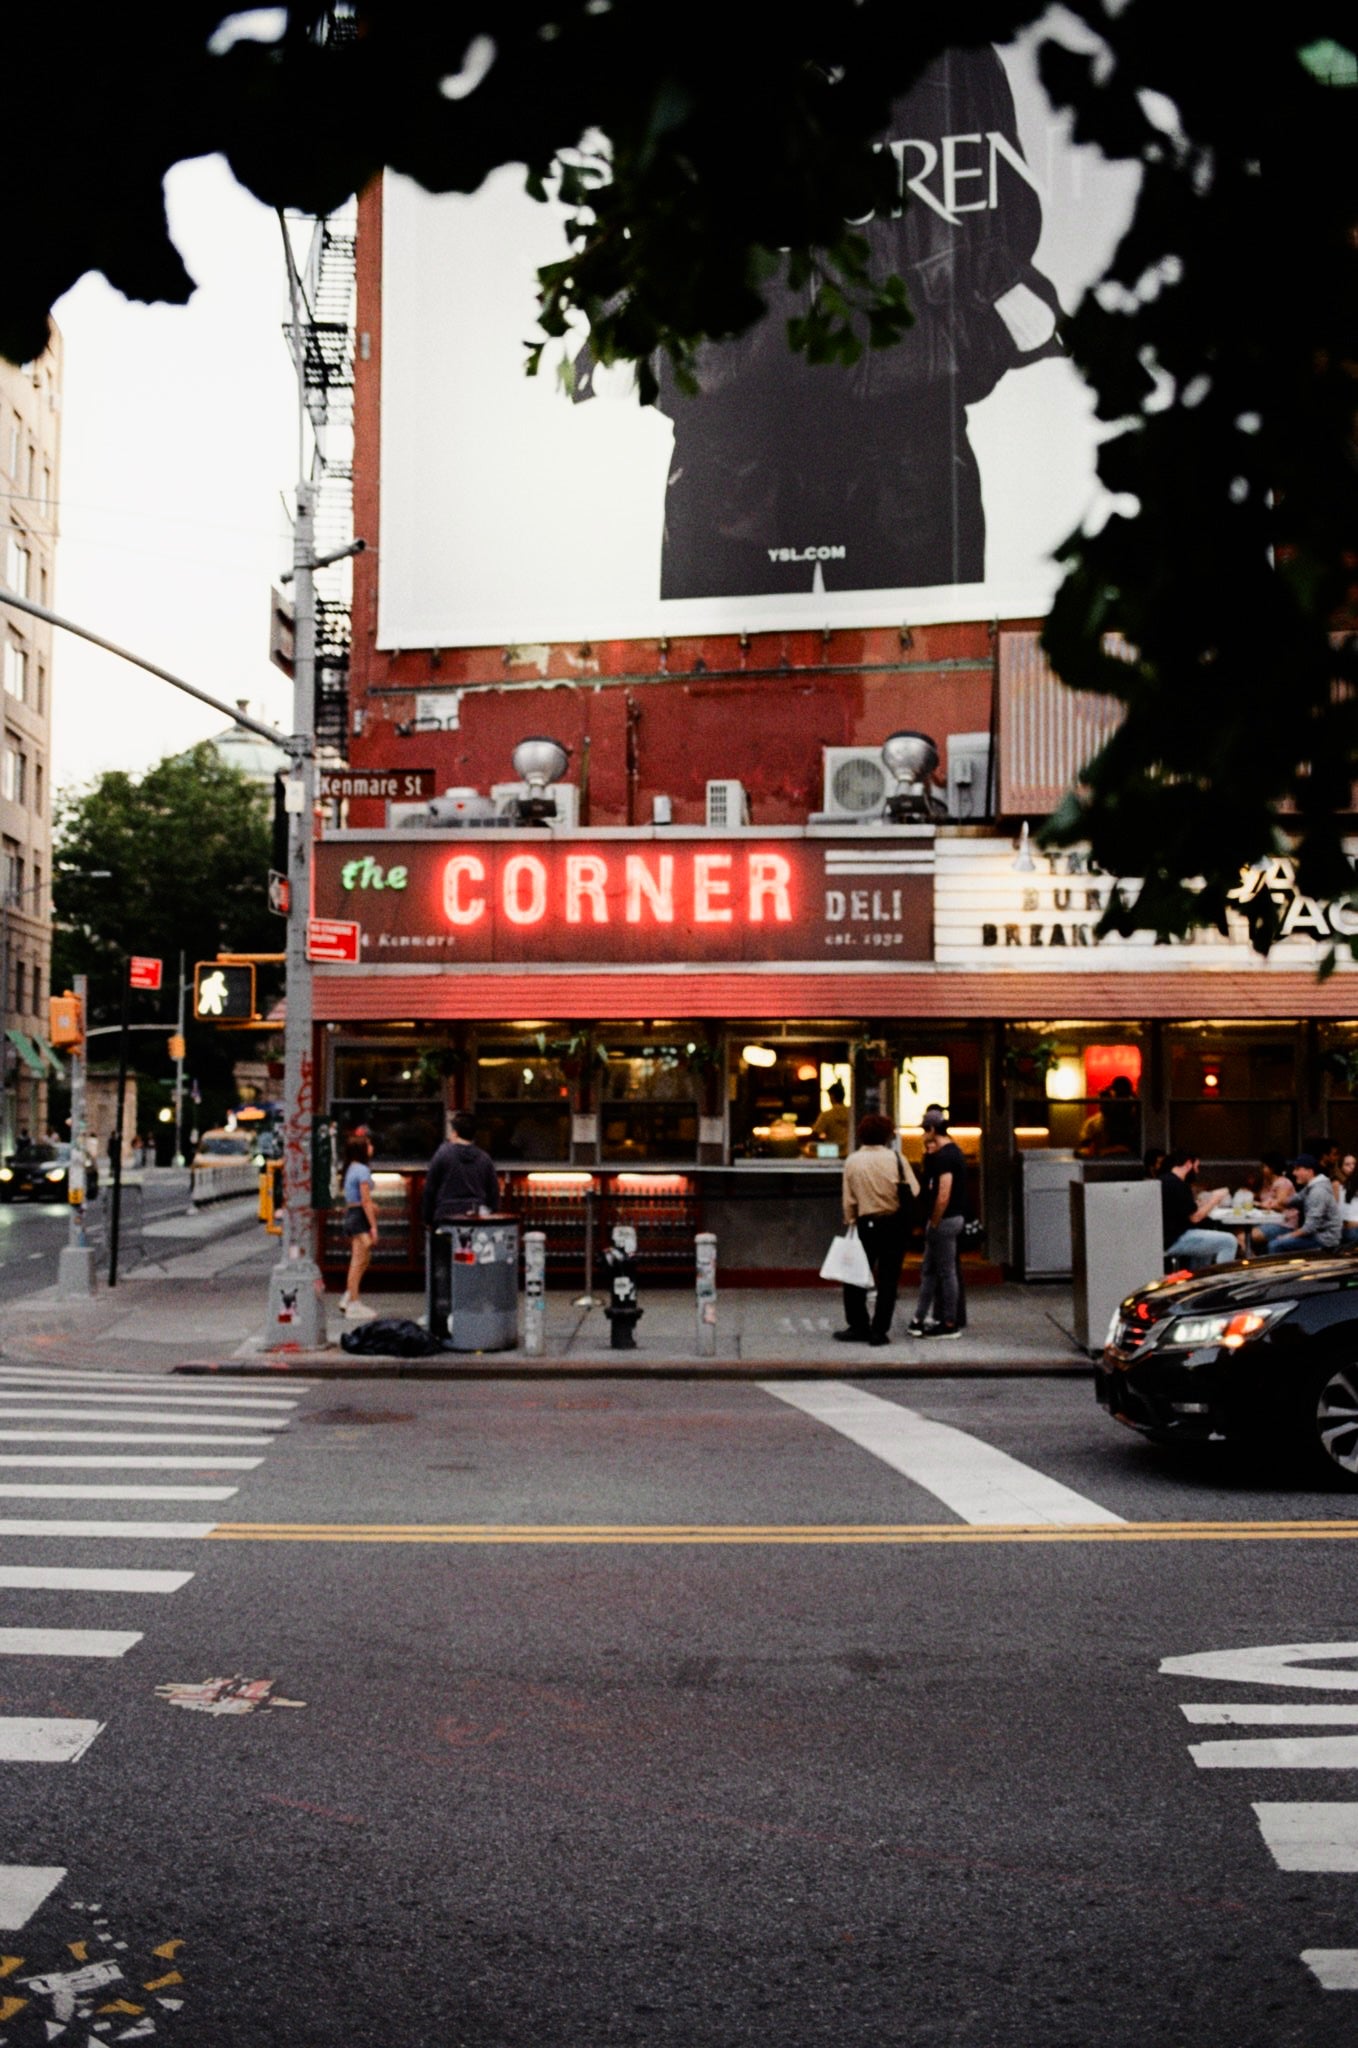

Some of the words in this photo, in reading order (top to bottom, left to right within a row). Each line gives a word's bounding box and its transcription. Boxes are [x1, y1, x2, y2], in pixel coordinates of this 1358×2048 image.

[768, 545, 846, 562] YSL.COM
[321, 776, 398, 796] Kenmare
[405, 775, 422, 796] St
[341, 856, 408, 890] the
[442, 853, 793, 925] CORNER
[825, 889, 902, 921] DELI
